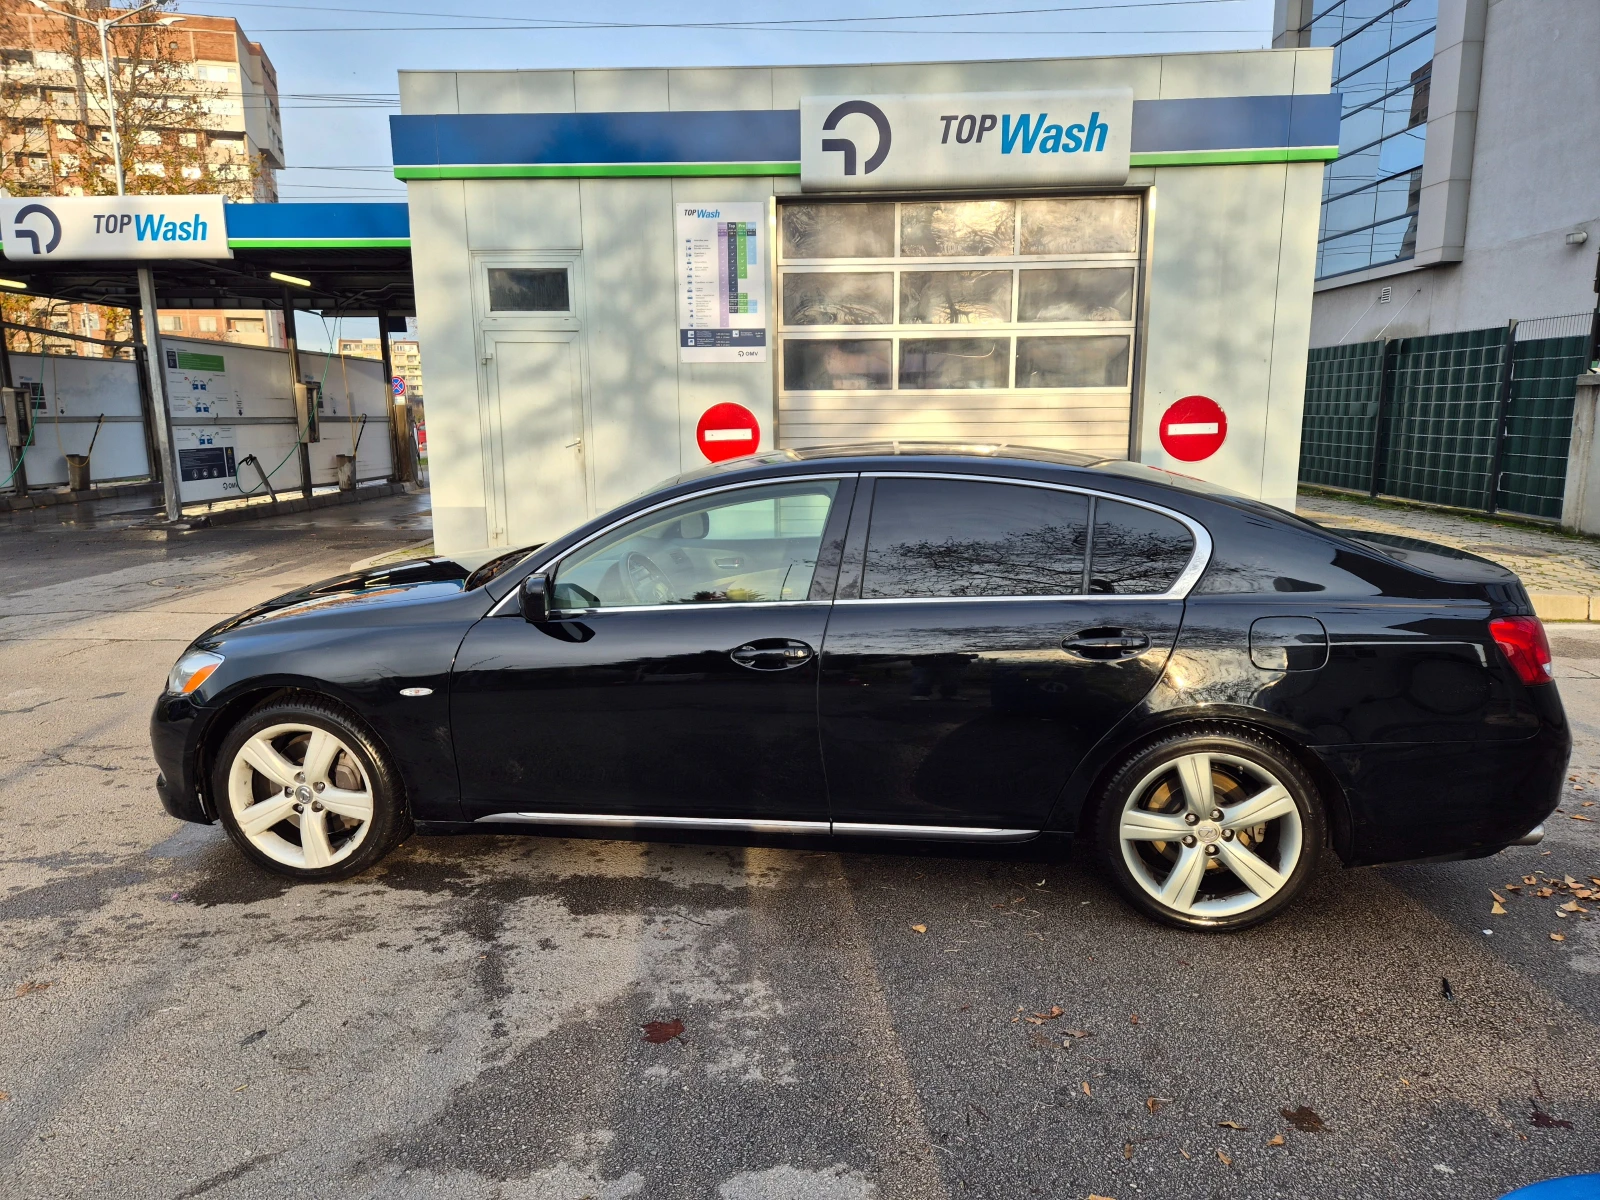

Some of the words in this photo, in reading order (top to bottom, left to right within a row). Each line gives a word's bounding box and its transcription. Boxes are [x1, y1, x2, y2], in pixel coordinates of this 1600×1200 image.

[940, 114, 998, 144] TOP
[1001, 112, 1109, 155] Wash
[93, 214, 132, 234] TOP
[135, 213, 208, 242] Wash
[697, 209, 720, 219] Wash
